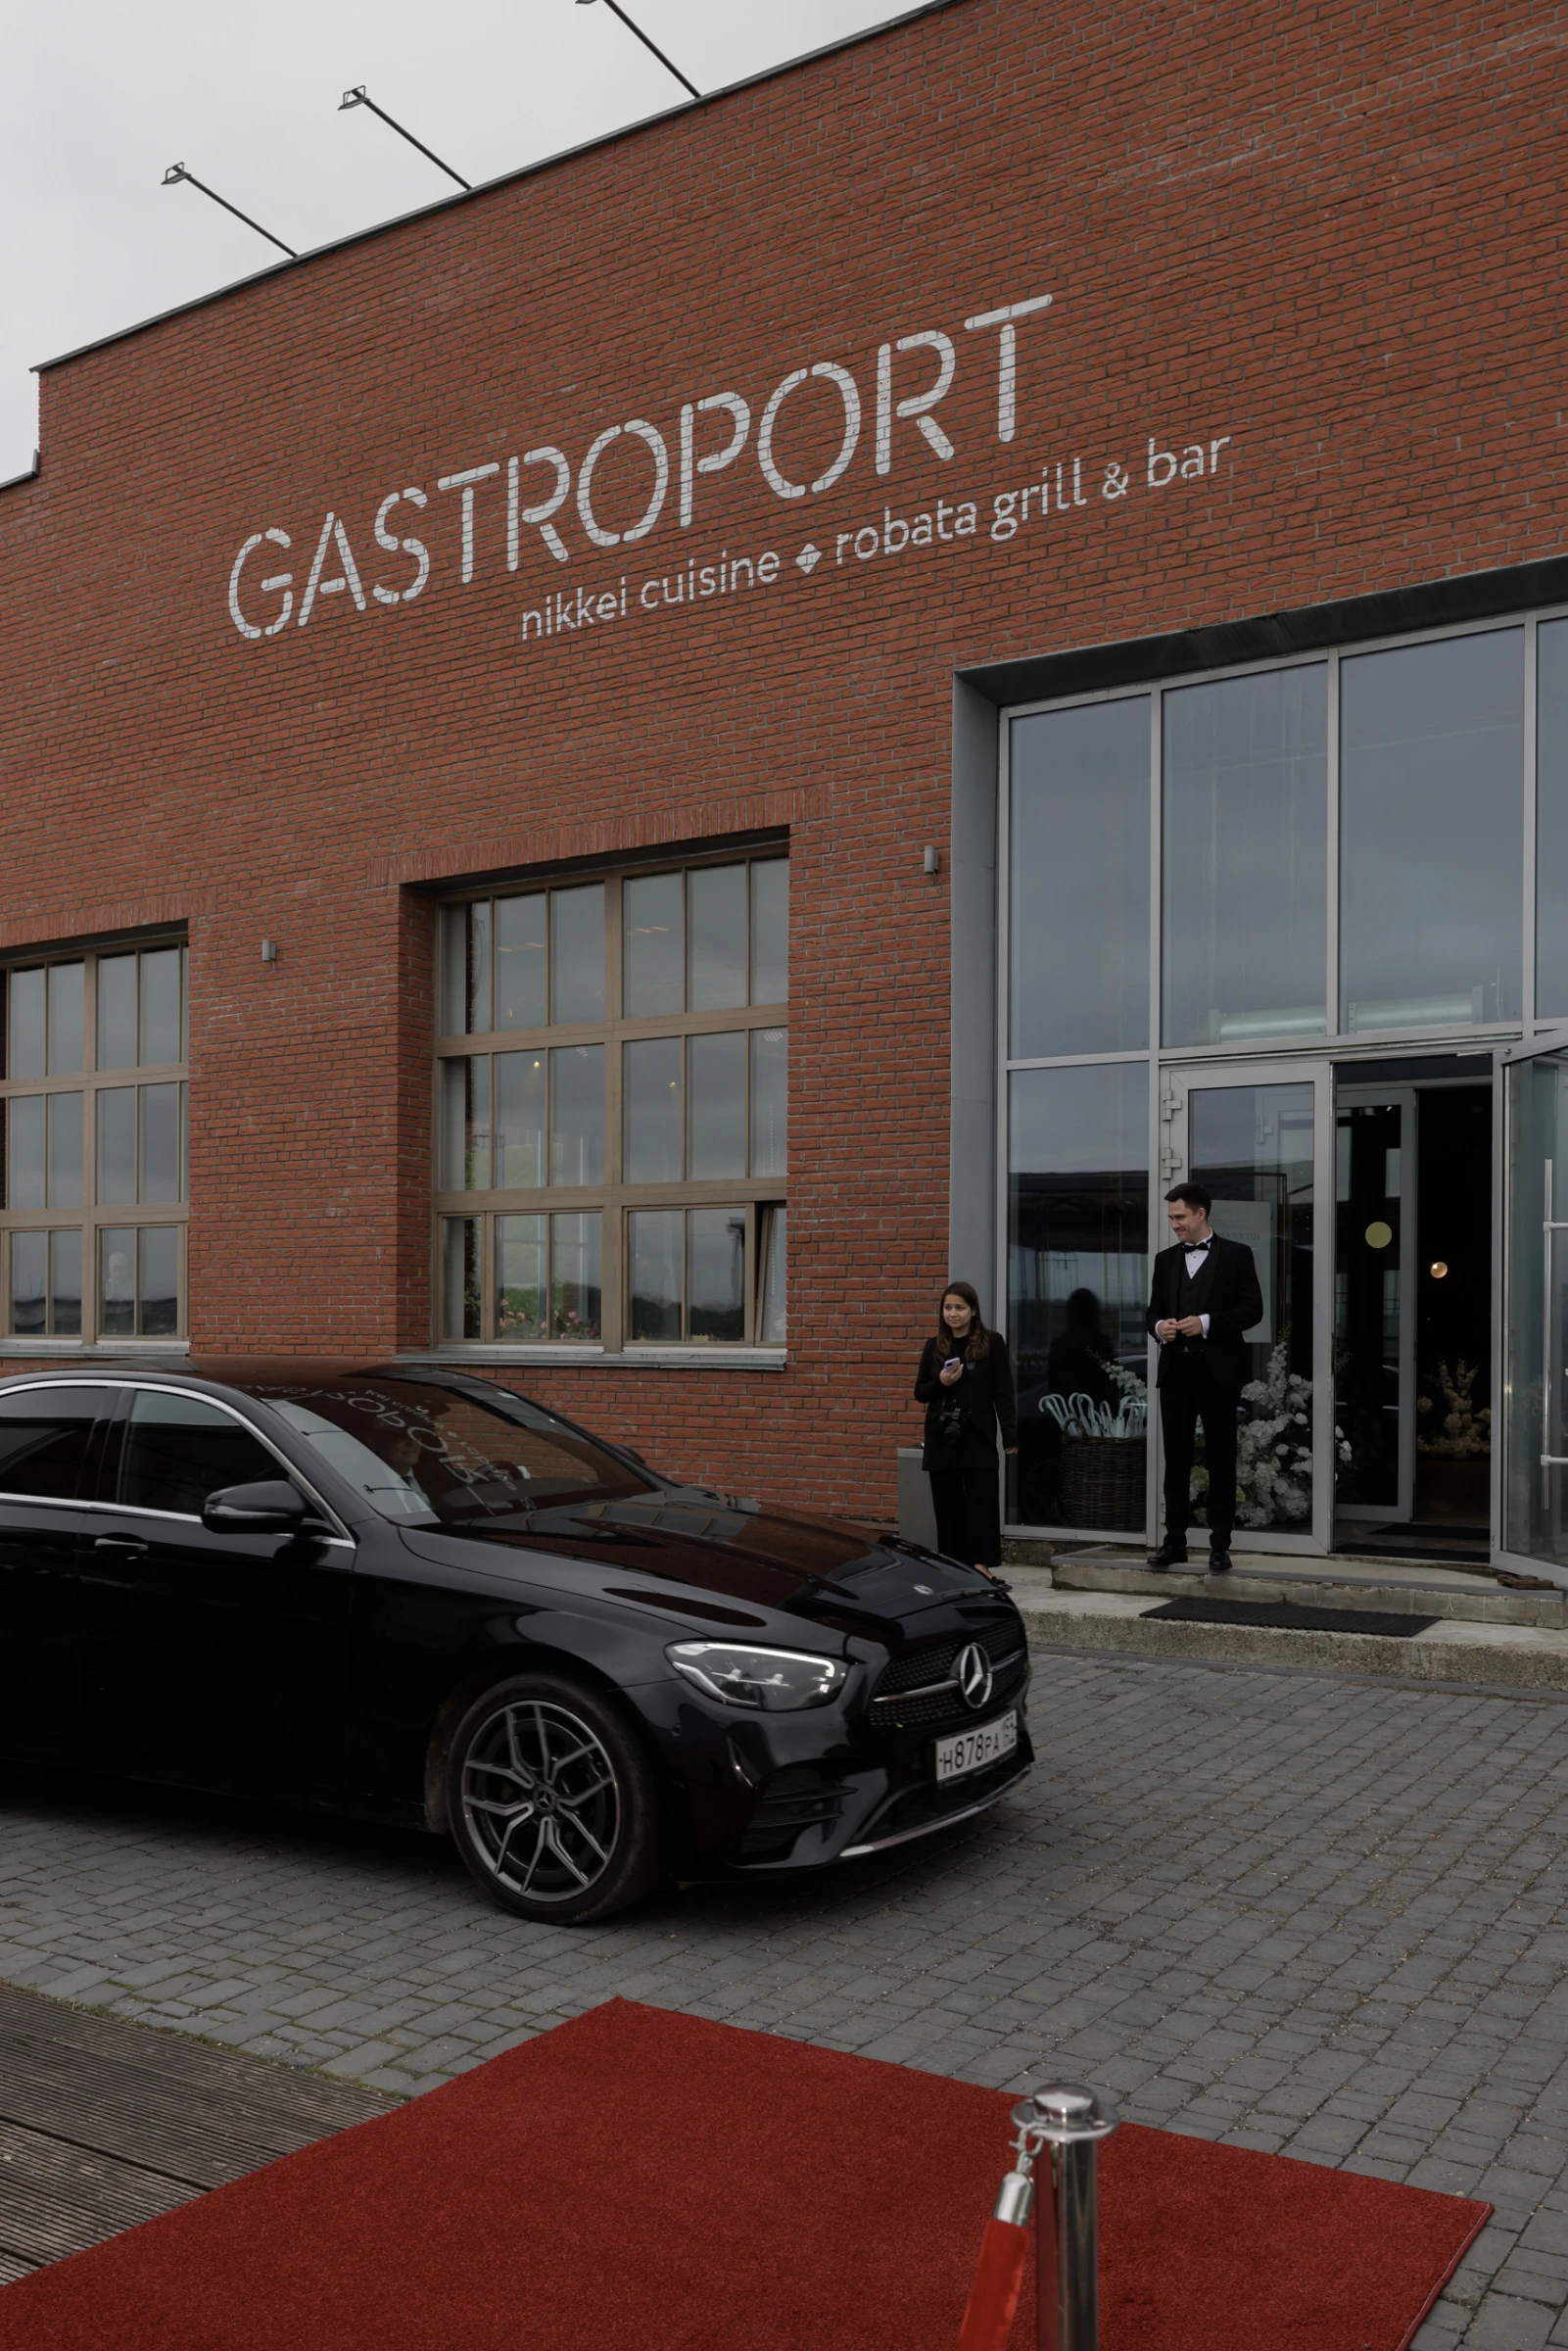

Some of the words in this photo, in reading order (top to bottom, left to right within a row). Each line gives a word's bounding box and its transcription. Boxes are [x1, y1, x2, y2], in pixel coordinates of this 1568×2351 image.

[228, 293, 1053, 640] GASTROPORT
[521, 576, 627, 640] nikkei
[640, 551, 781, 609] cuisine
[835, 500, 977, 565] robata
[990, 457, 1088, 541] grill
[1102, 461, 1129, 501] &
[1147, 436, 1231, 488] bar
